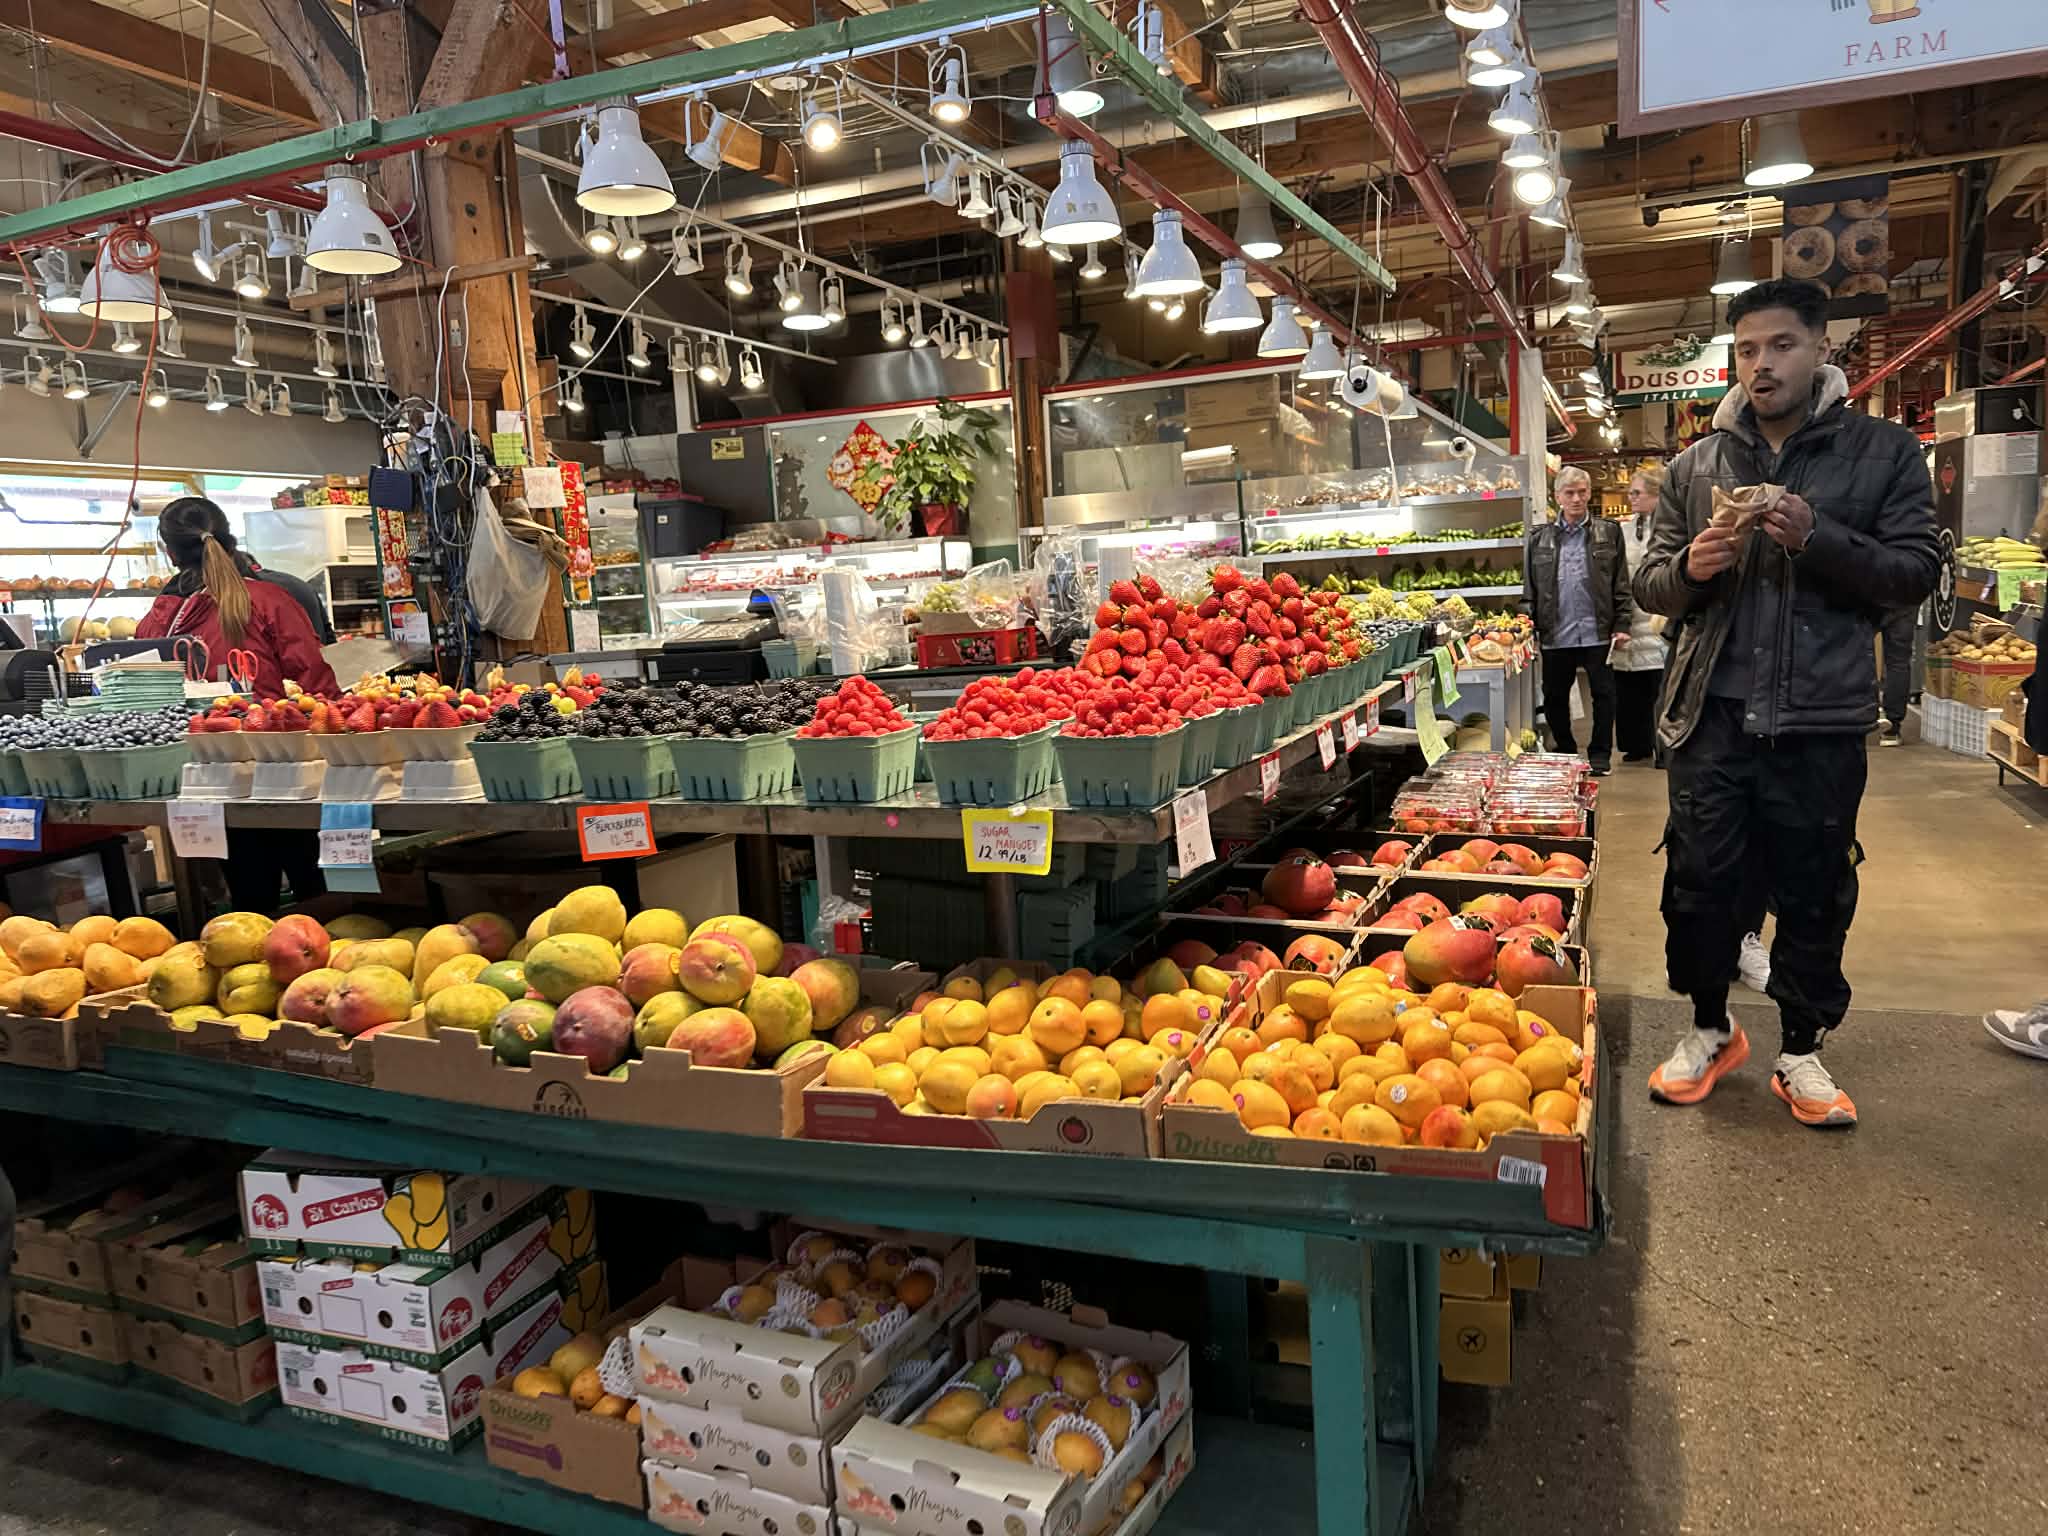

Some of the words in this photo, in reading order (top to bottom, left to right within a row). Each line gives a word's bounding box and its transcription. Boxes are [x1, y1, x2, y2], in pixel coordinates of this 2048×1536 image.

[1842, 29, 1949, 67] FARM
[1643, 390, 1699, 402] ITALIA
[980, 825, 1013, 839] SUGAR
[329, 1195, 379, 1218] Carlos
[326, 1246, 375, 1260] MANGO
[406, 1253, 453, 1266] ATAULFO
[272, 1327, 322, 1346] MANGO
[364, 1344, 431, 1365] ATAULFO
[380, 1428, 447, 1452] ATAULFO
